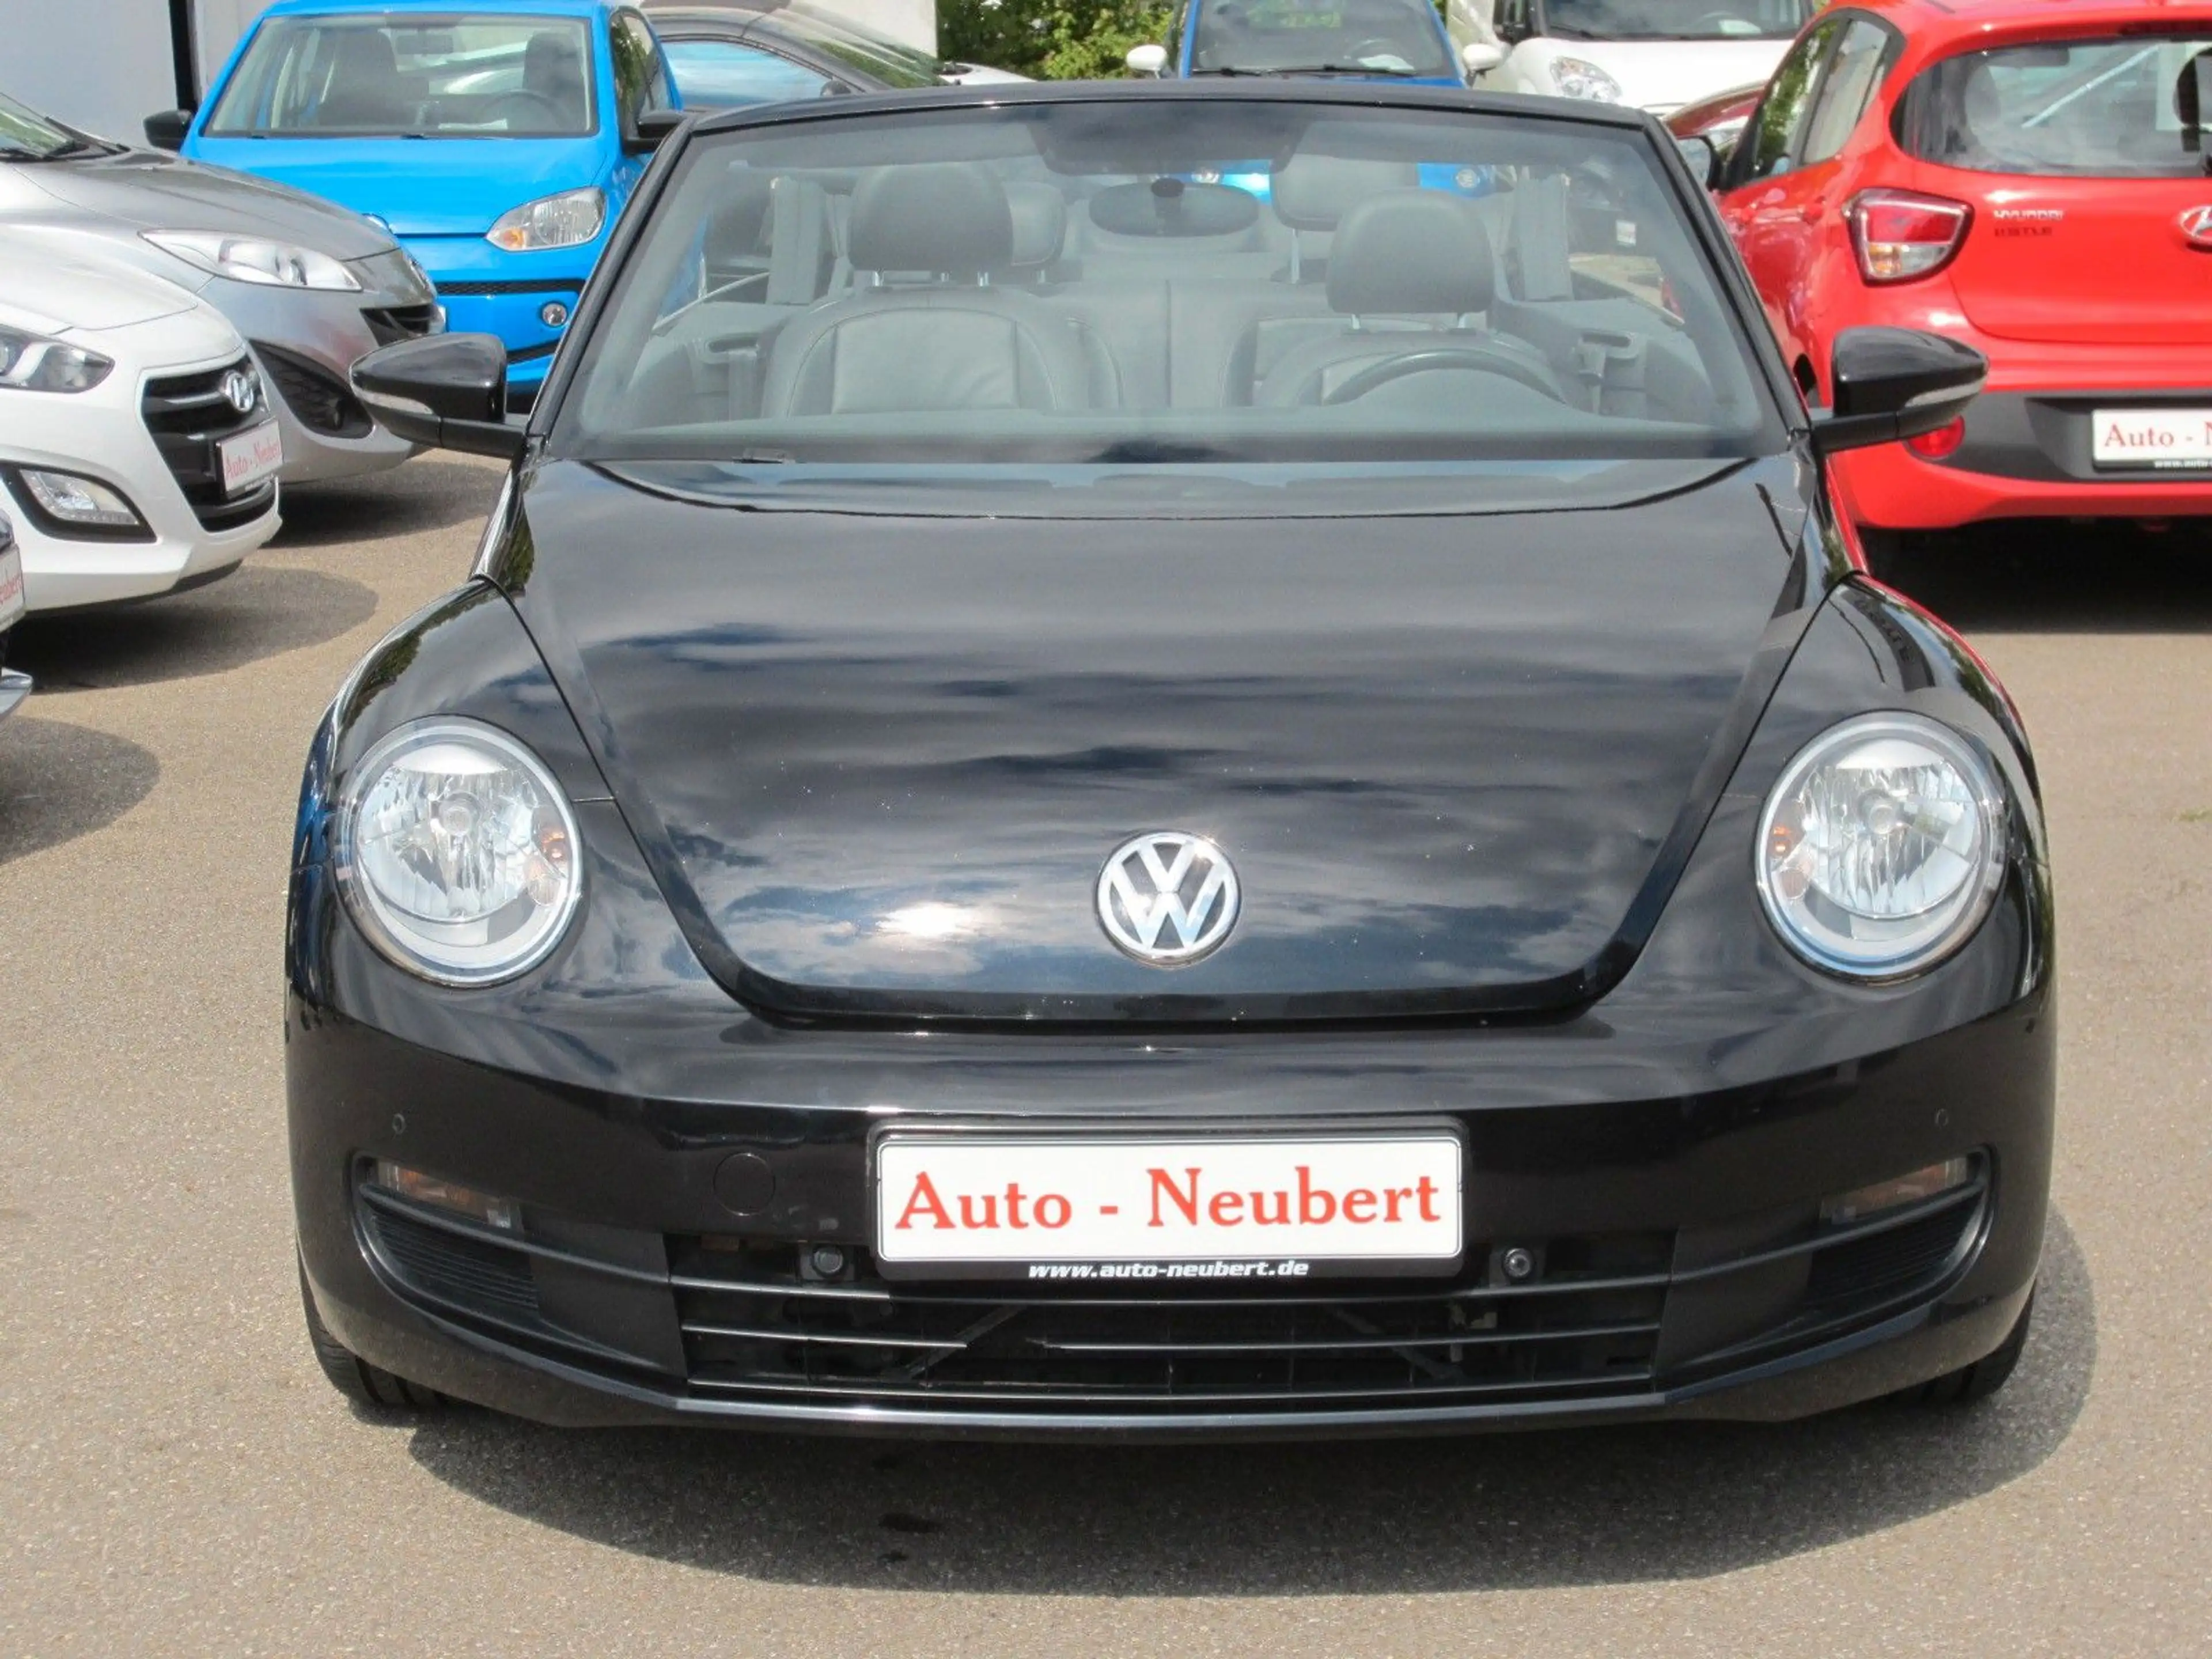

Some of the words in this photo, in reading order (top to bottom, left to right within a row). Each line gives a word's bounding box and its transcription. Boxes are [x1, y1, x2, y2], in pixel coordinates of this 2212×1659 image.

[2104, 424, 2174, 448] Auto
[895, 1171, 1073, 1230] Auto
[1099, 1205, 1119, 1216] -
[1148, 1165, 1440, 1228] Neubert
[1028, 1259, 1310, 1279] www.auto-neubert.de
